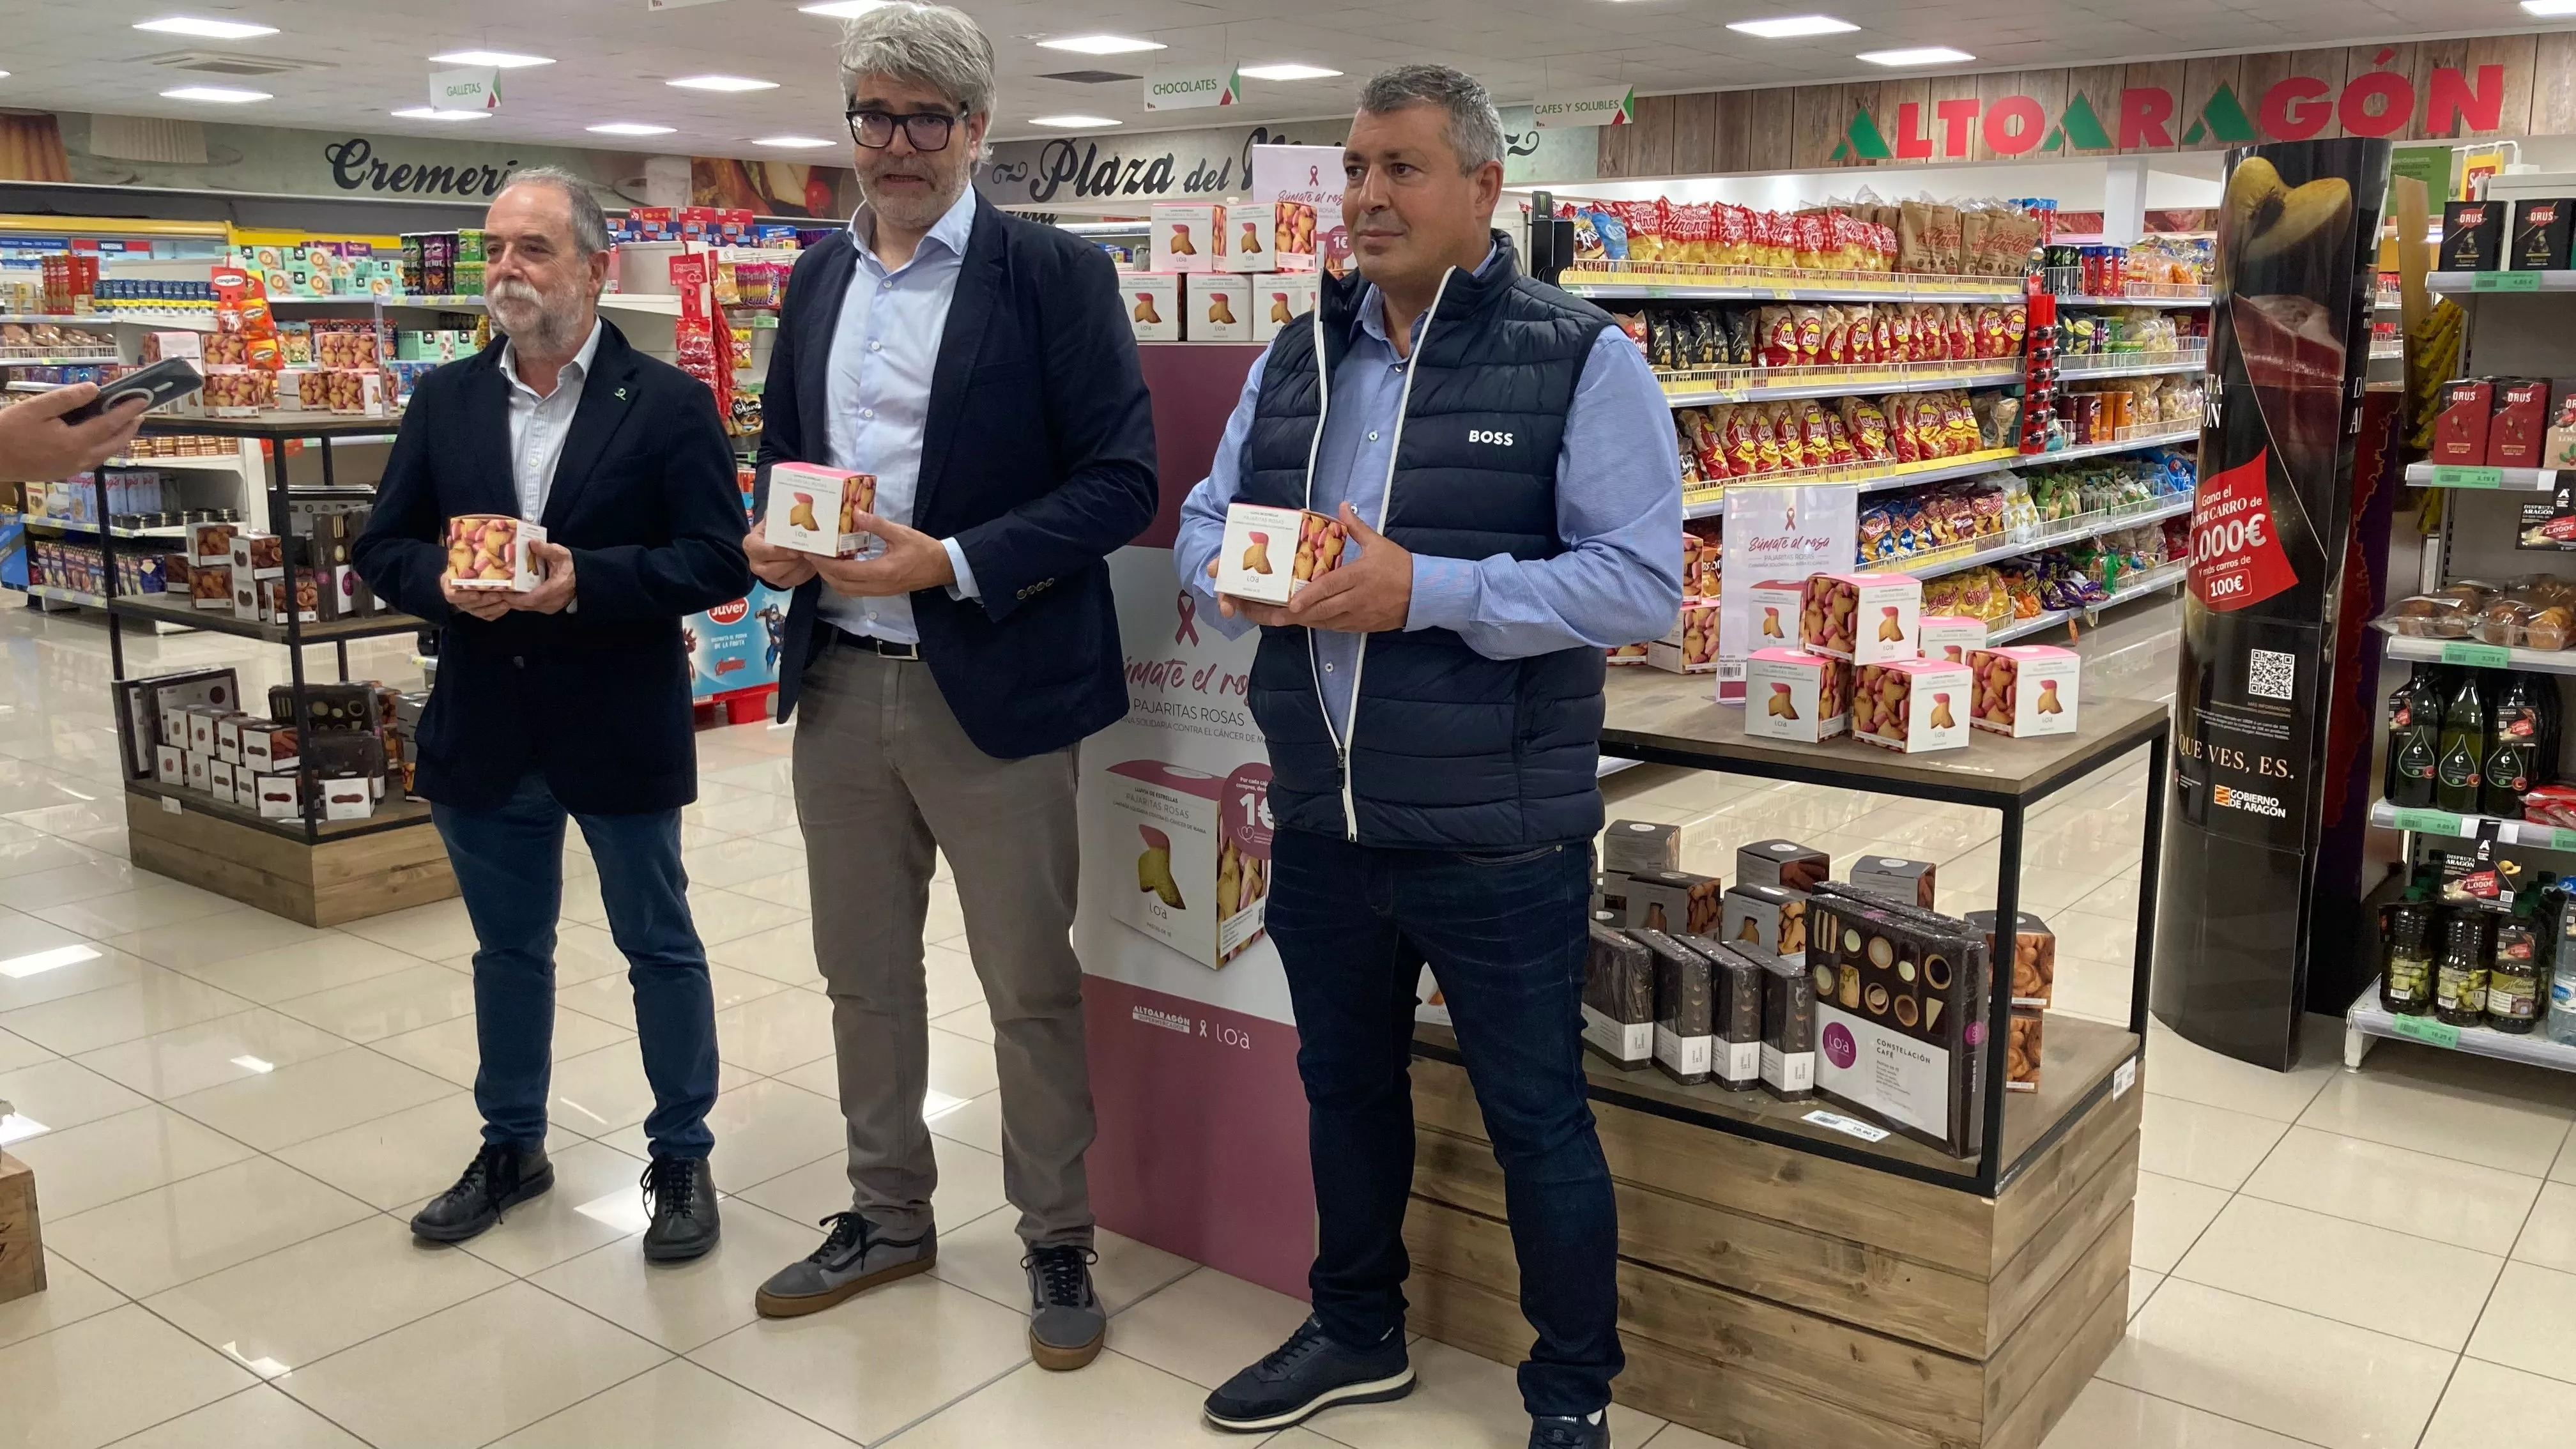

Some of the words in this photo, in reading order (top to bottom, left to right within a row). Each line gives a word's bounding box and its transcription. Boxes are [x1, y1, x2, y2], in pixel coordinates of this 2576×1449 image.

[447, 82, 482, 96] GALLETAS
[1153, 79, 1217, 95] CHOCOLATES
[1535, 103, 1563, 114] CAFES
[1565, 103, 1572, 112] Y
[1575, 100, 1619, 112] SOLUBLES
[1029, 137, 1176, 203] Plaza
[1183, 156, 1230, 193] del
[1315, 192, 1326, 203] al
[1327, 194, 1343, 206] ros
[2566, 399, 2576, 408] OR
[1469, 430, 1514, 446] BOSS
[2202, 491, 2221, 507] Gana
[2223, 484, 2232, 497] el
[2250, 496, 2262, 507] de
[1790, 535, 1804, 549] al
[2203, 566, 2215, 576] más
[2216, 561, 2239, 571] carros
[2241, 555, 2251, 565] de
[2211, 575, 2244, 597] 100€
[1123, 656, 1188, 694] úmate
[1192, 663, 1211, 694] el
[1220, 673, 1250, 707] ro
[1134, 698, 1197, 720] PAJARITAS
[1201, 707, 1245, 726] ROSAS
[1136, 718, 1172, 730] SOLIDARIA
[1174, 723, 1203, 735] CONTRA
[1245, 734, 1256, 743] DE
[2179, 735, 2202, 760] QUE
[2208, 745, 2250, 774] VES,
[2260, 756, 2295, 779] ES.
[1135, 787, 1148, 795] LLUVIA
[1156, 792, 1179, 804] ESTRELLAS
[2229, 798, 2241, 809] DE
[2230, 790, 2280, 808] GOBIERNO
[1126, 793, 1162, 811] PAJARITAS
[1164, 804, 1190, 819] ROSAS
[1239, 793, 1275, 831] 1€
[2446, 854, 2476, 862] DISFRUTA
[2446, 859, 2475, 868] ARAGÓN
[1133, 1006, 1190, 1025] ALTOARAGÓN
[1876, 1038, 1931, 1064] CONSTELACIÓN
[1876, 1047, 1894, 1059] CAFÉ
